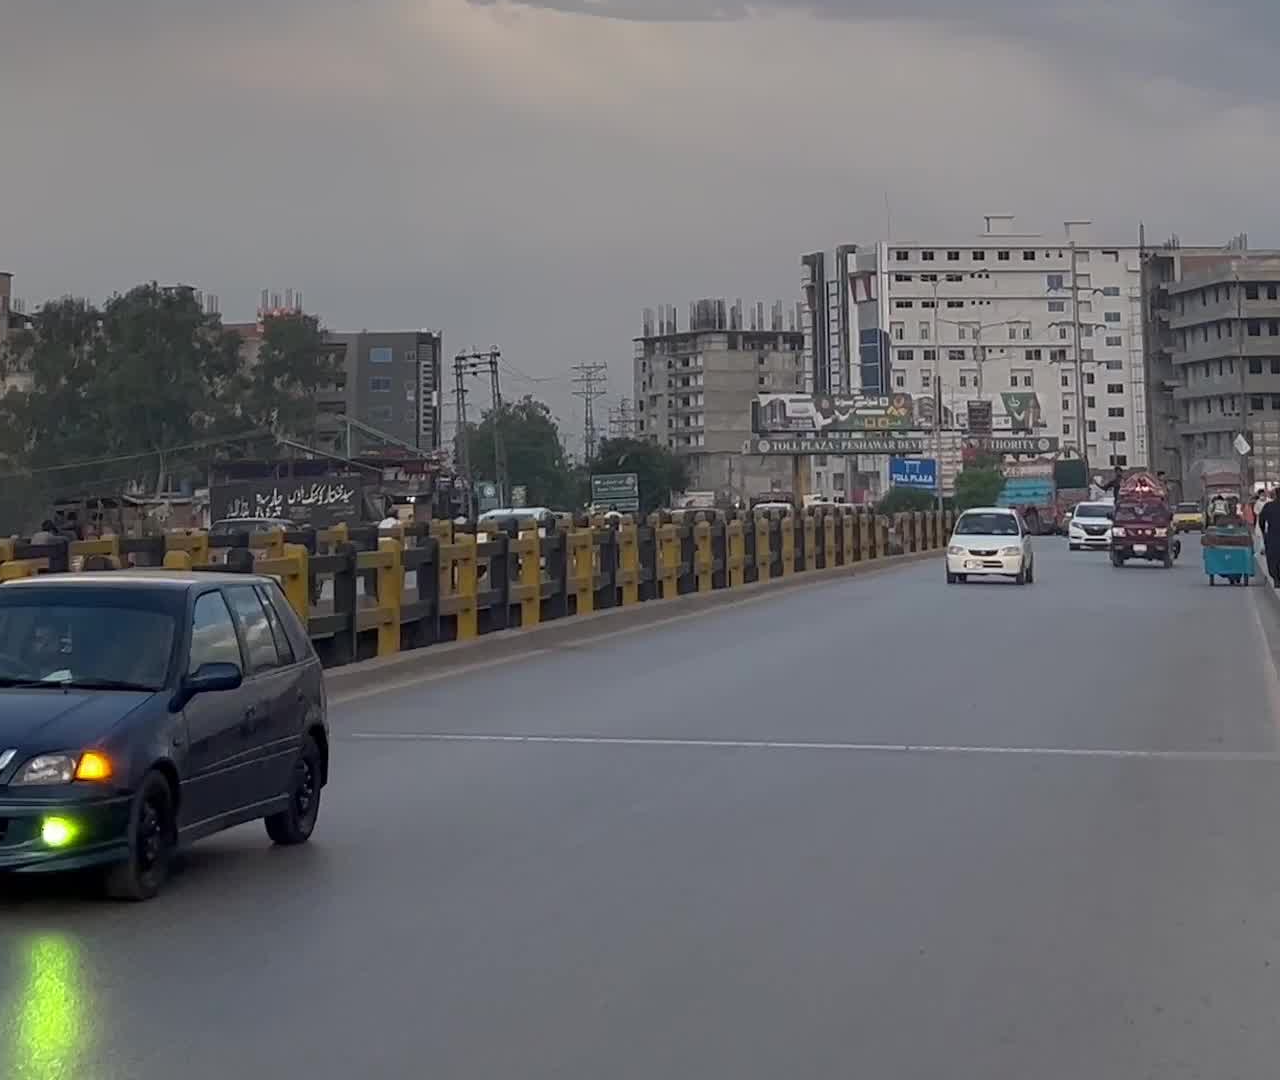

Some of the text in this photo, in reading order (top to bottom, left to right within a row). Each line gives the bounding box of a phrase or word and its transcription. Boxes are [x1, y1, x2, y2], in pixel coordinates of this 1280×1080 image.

[772, 441, 798, 451] TOLL
[801, 441, 834, 450] PLAZA
[841, 439, 896, 450] PESHAWAR
[978, 439, 1035, 450] THORITY
[910, 473, 934, 482] PLAZA
